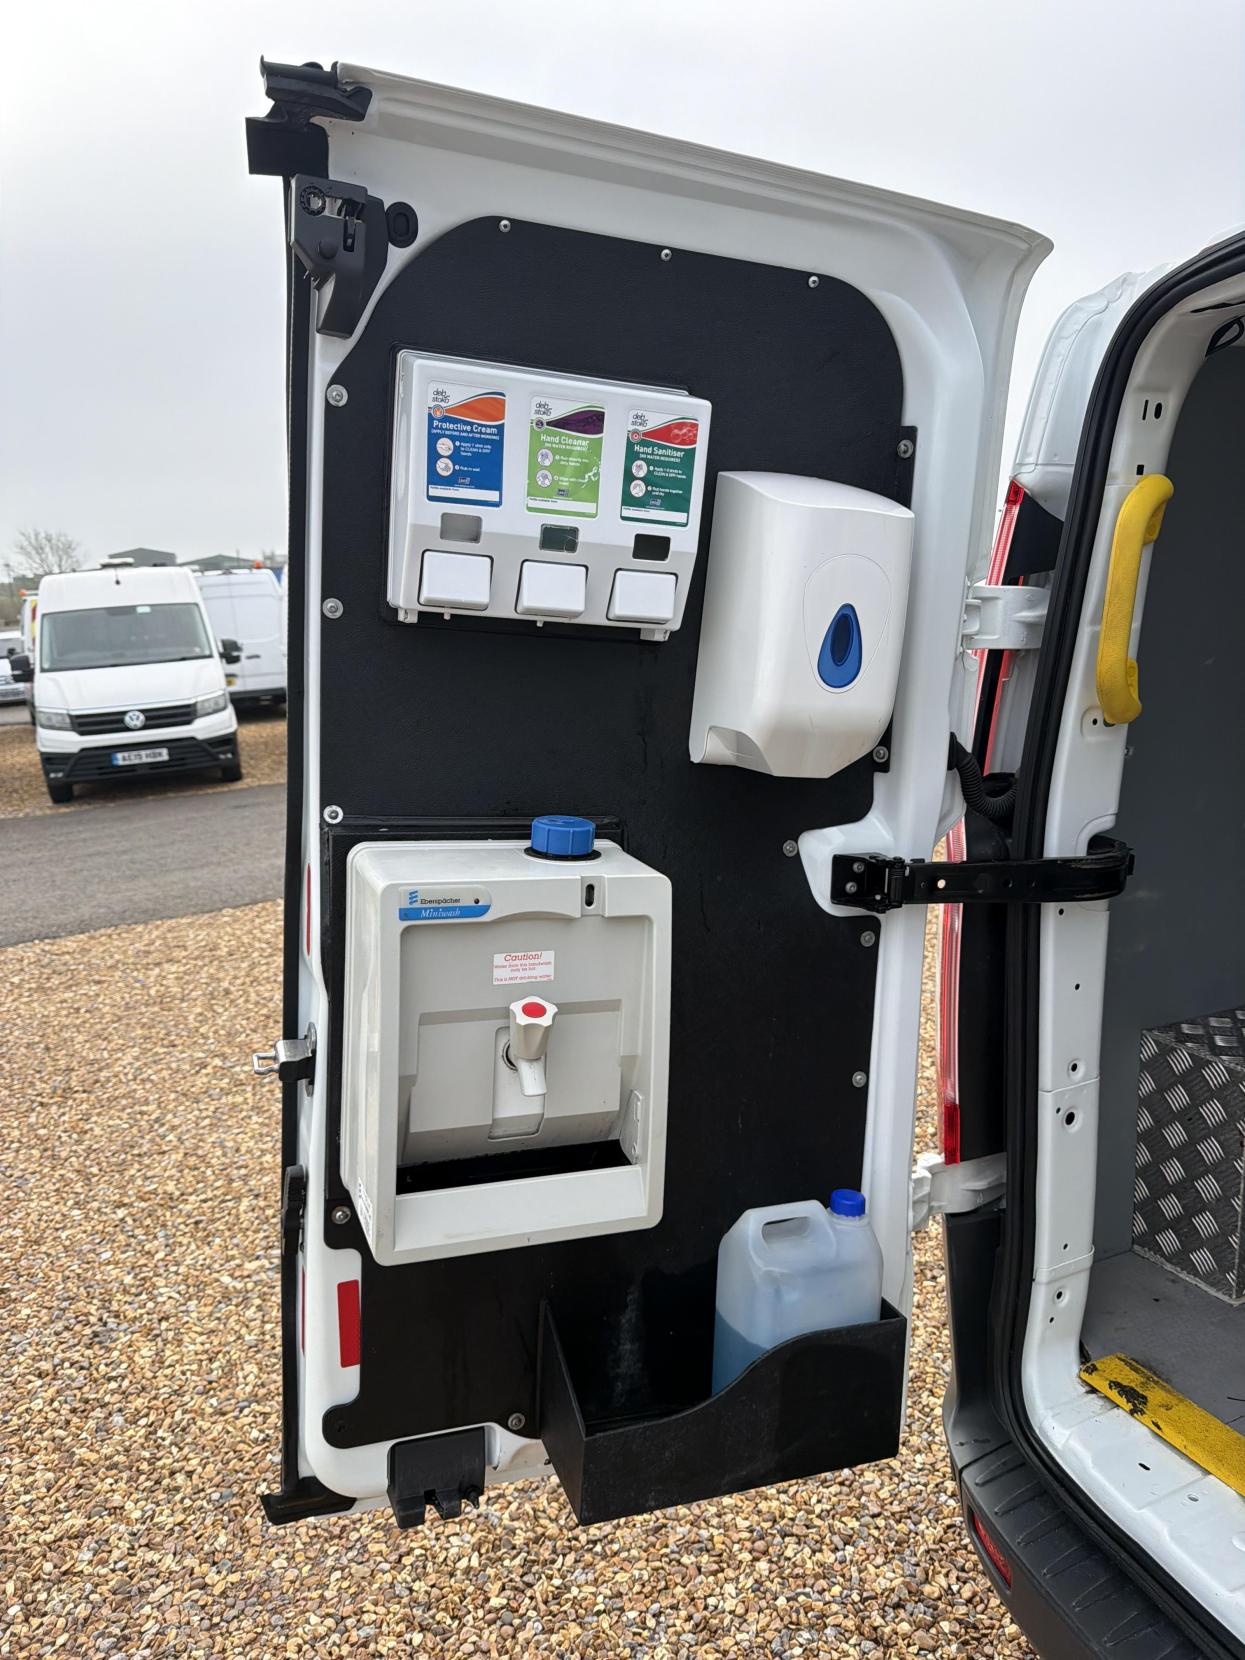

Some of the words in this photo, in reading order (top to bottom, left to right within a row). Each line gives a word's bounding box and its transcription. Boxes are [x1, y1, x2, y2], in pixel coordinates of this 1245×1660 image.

[433, 420, 471, 431] Protective
[473, 424, 498, 434] Cream
[540, 434, 560, 443] Hand
[561, 437, 590, 446] Cleaner
[634, 444, 652, 453] Hand
[654, 447, 684, 457] Sanitiser
[504, 952, 542, 961] Caution!
